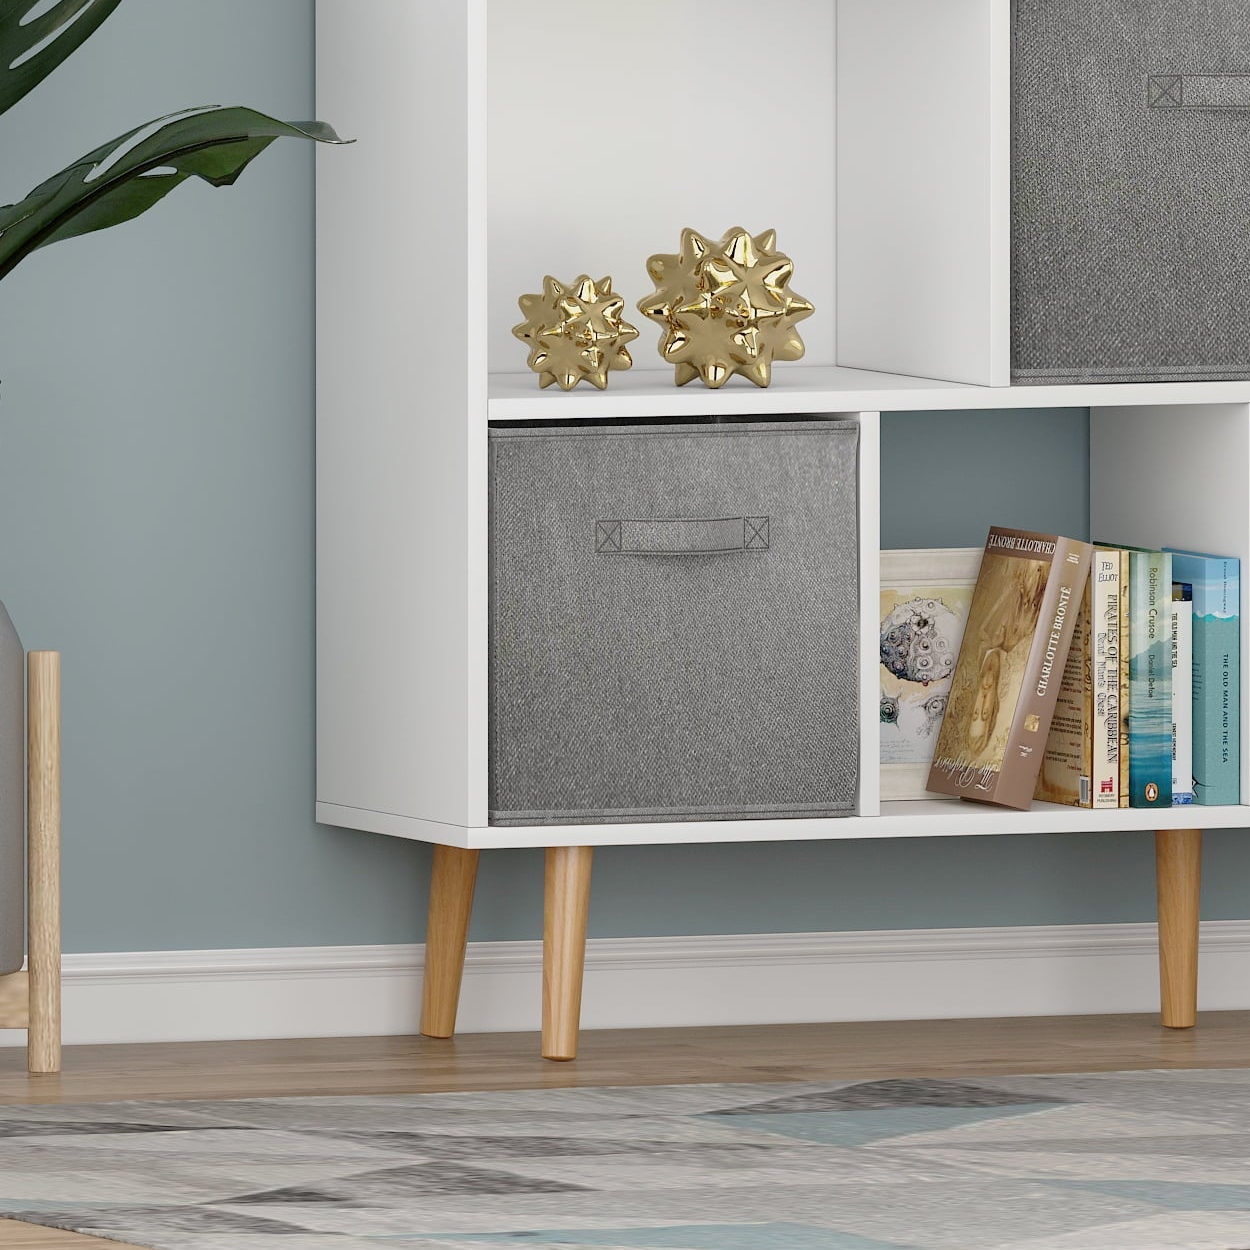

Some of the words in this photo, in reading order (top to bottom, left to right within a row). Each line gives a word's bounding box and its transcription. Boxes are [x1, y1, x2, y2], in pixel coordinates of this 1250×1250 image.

[1017, 538, 1056, 555] CHARLOTTE
[1101, 561, 1113, 571] TED
[1148, 567, 1158, 606] Robinson
[1104, 594, 1118, 643] PIRATES
[1148, 608, 1158, 639] Crusoe
[1036, 631, 1060, 696] CHARLOTTE
[1105, 646, 1118, 663] OF
[1148, 654, 1156, 677] Daniel
[1107, 667, 1118, 691] THE
[1148, 677, 1156, 698] Defoe
[1104, 694, 1118, 764] CARIBBEAN
